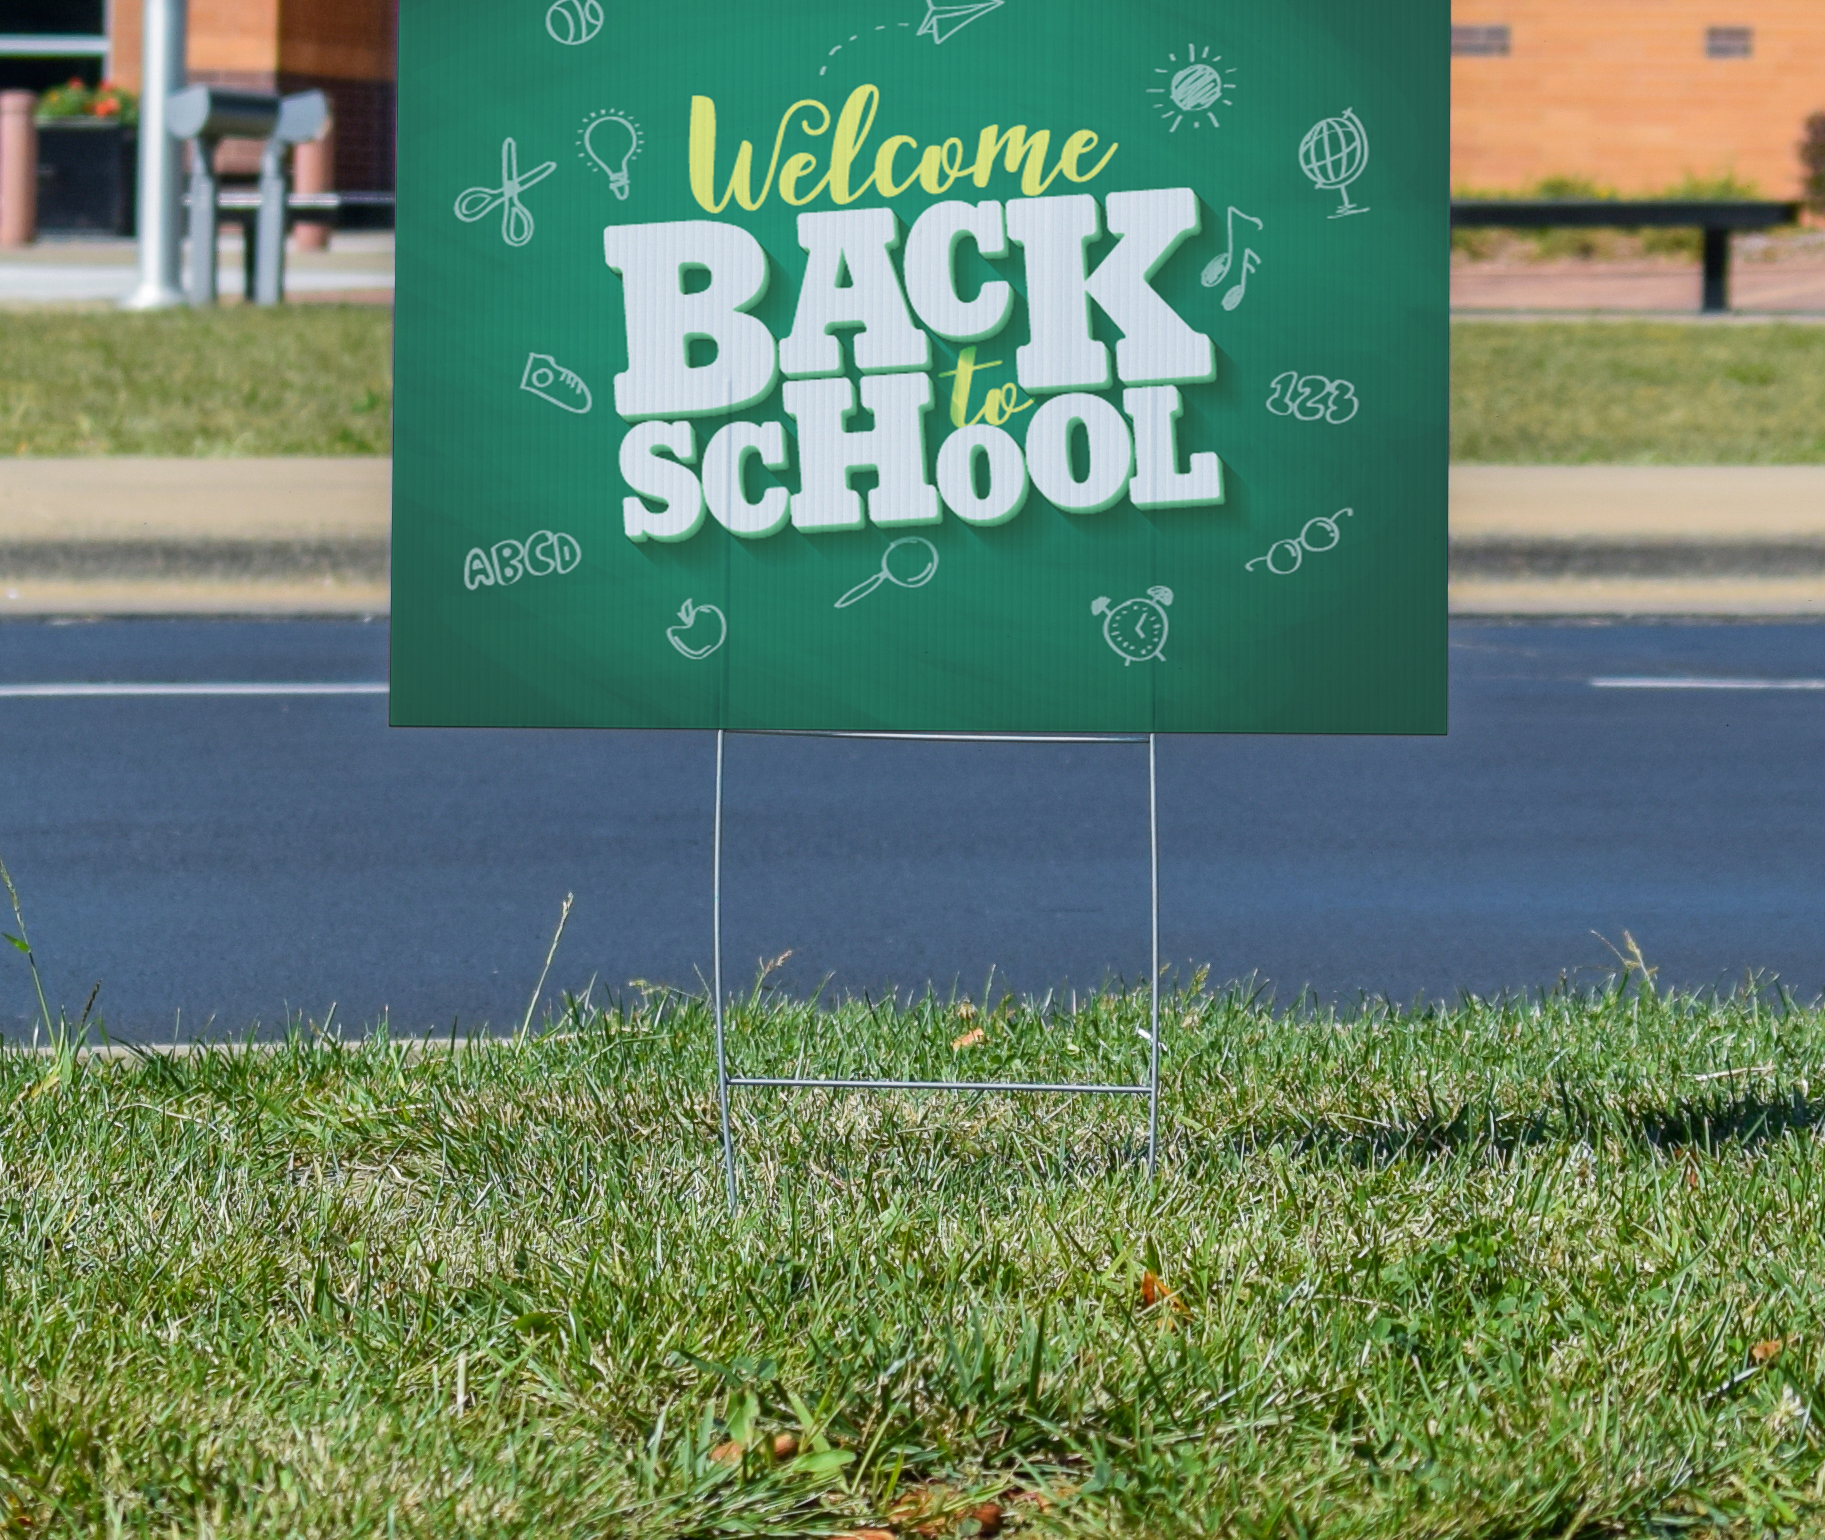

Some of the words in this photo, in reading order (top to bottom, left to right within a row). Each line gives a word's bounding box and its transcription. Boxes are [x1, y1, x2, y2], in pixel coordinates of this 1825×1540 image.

[689, 84, 1119, 213] Welcome
[604, 188, 1216, 422] BACK
[939, 346, 1034, 428] to
[1266, 370, 1359, 424] 123
[619, 372, 1226, 542] SCHOOL
[464, 530, 581, 590] ABCD
